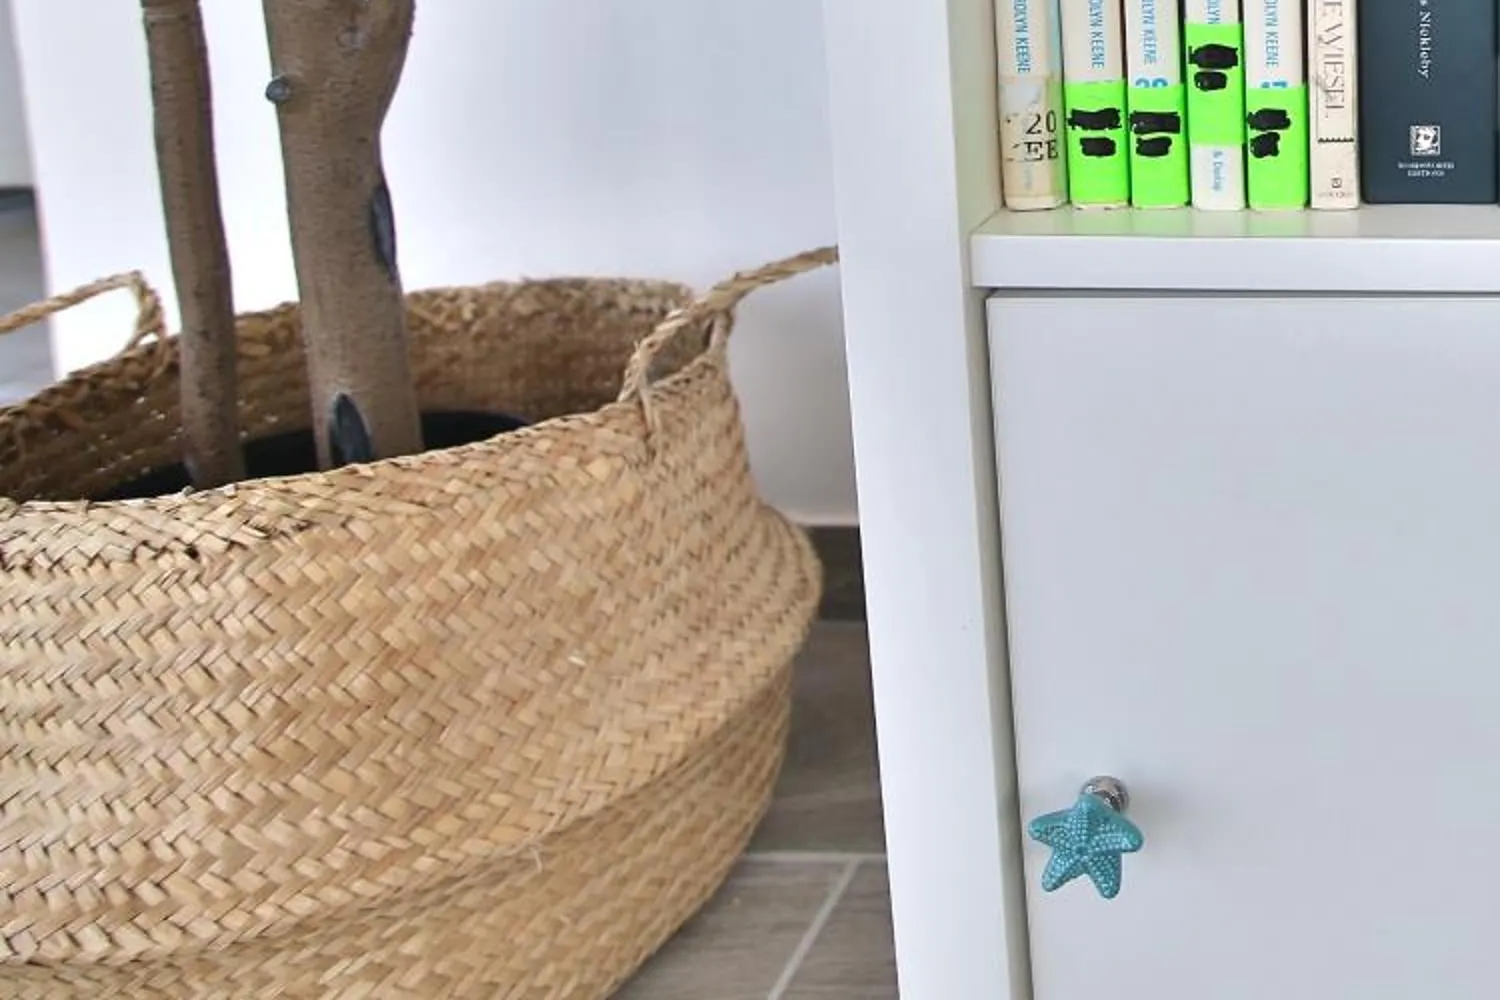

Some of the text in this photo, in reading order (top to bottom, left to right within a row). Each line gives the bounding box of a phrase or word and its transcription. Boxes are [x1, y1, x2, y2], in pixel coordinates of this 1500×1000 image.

[1015, 35, 1031, 73] KEENE
[1090, 30, 1105, 69] KEENE
[1142, 28, 1156, 65] KEENE
[1265, 31, 1279, 68] KEENE
[1416, 11, 1431, 79] Nickleby
[1320, 22, 1344, 118] WIESEL
